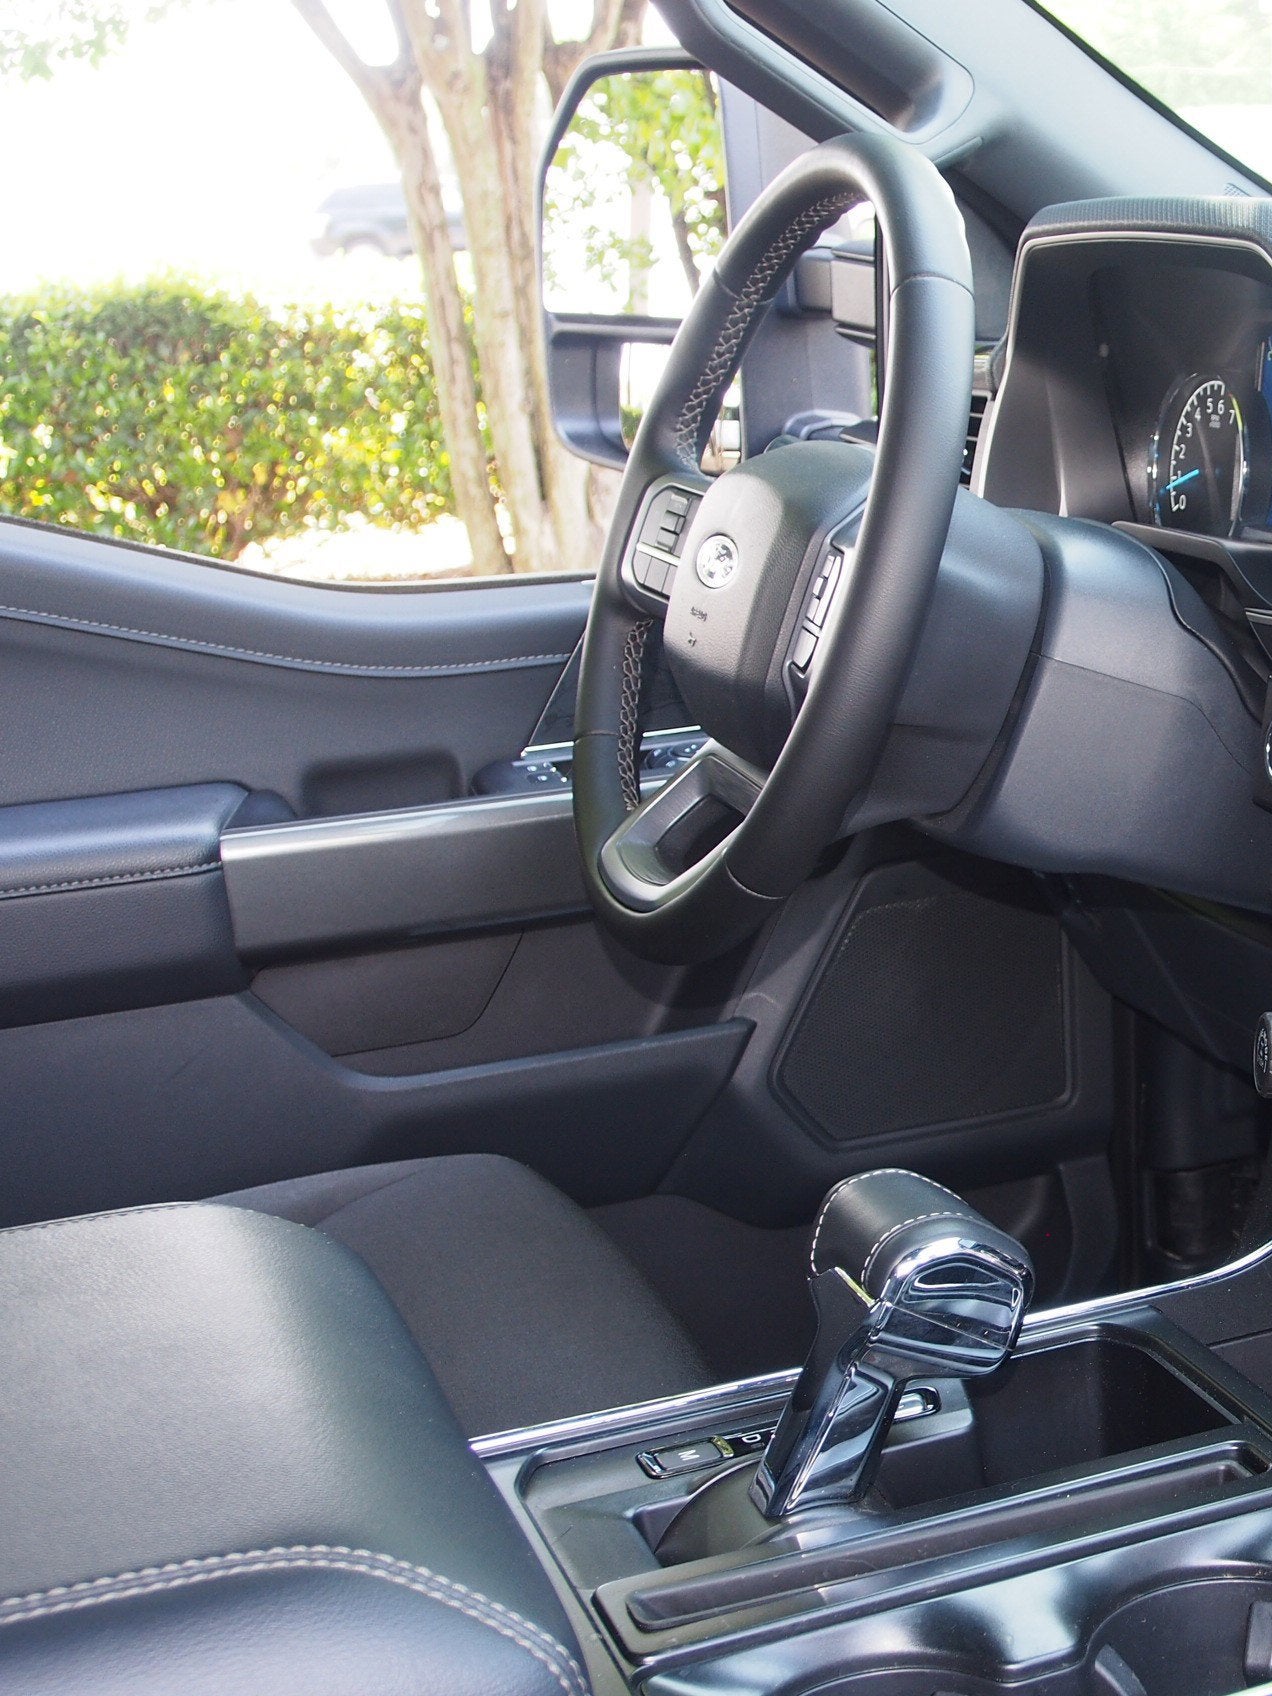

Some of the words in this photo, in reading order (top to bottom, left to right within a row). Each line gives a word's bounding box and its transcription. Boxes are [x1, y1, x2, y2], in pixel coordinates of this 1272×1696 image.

[1195, 406, 1201, 421] 4
[1206, 398, 1213, 413] 5
[1218, 399, 1225, 415] 6
[1229, 409, 1236, 425] 7
[1185, 422, 1193, 437] 3
[1179, 444, 1186, 459] 2
[1179, 495, 1187, 510] 0
[678, 1449, 700, 1461] M
